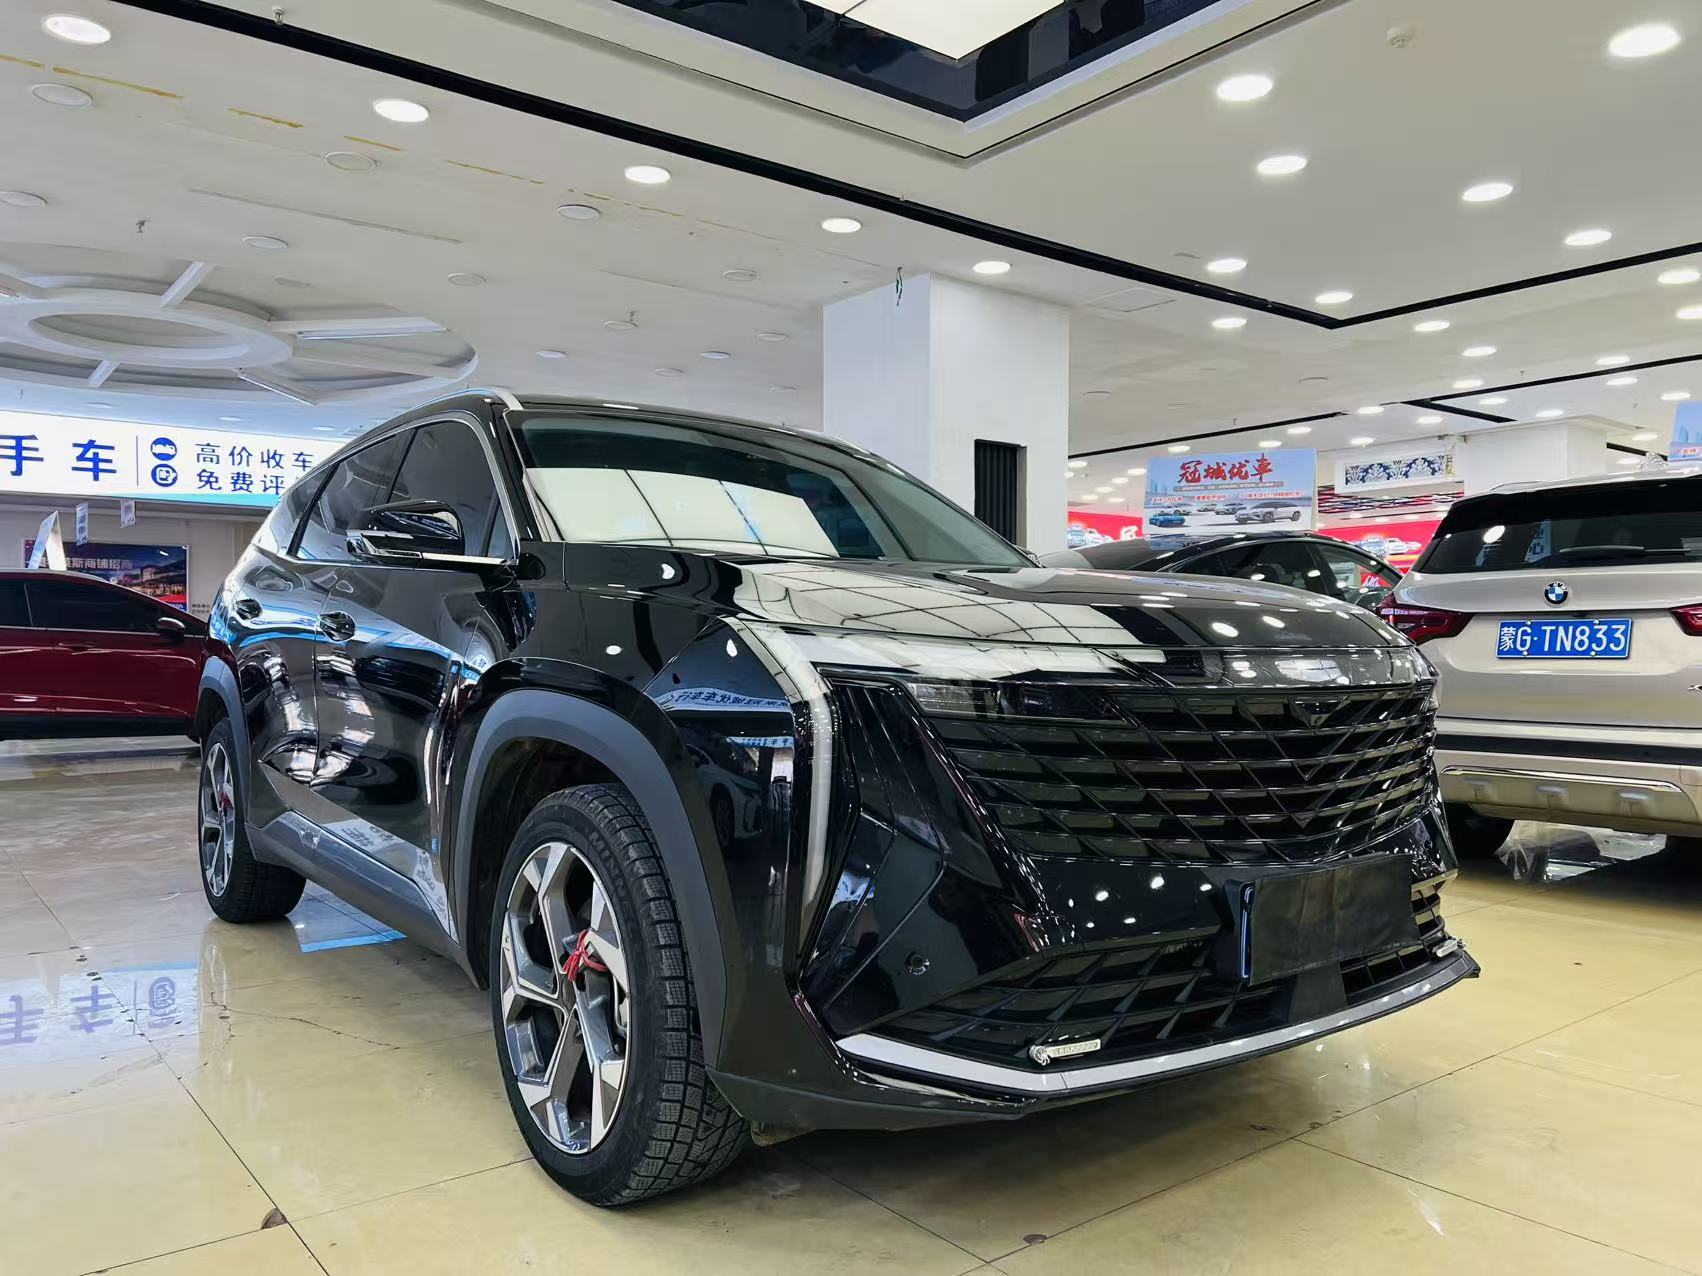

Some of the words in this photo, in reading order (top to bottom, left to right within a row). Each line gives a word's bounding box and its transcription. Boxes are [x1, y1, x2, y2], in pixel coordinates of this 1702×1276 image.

[195, 442, 314, 472] 高价收车
[196, 469, 290, 496] 免费评
[1499, 624, 1626, 652] 蒙G·TN833
